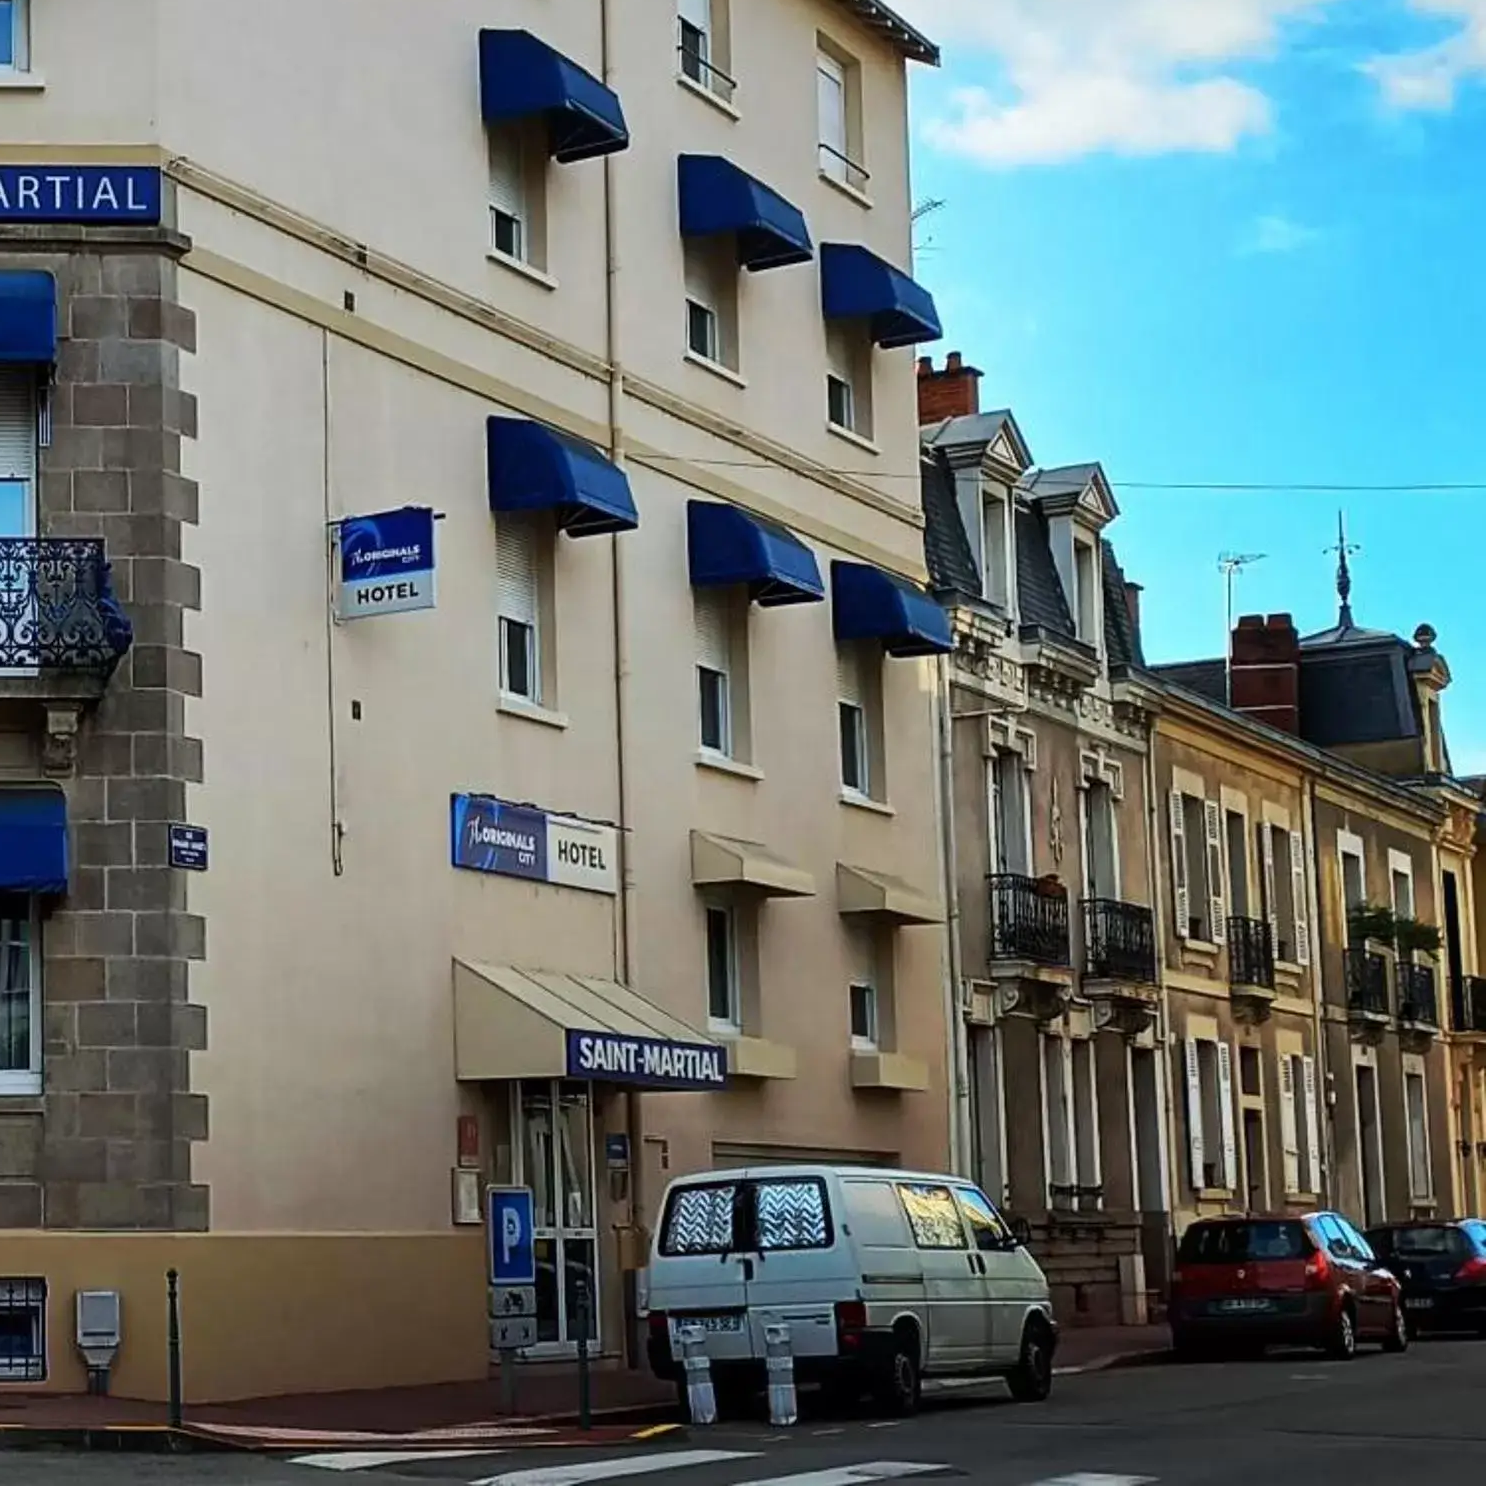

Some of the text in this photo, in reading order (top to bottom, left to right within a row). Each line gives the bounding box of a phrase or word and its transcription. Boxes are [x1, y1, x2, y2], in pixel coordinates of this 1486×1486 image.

[364, 545, 420, 561] ORIGINALS
[357, 582, 419, 605] HOTEL
[482, 826, 535, 851] ORIGINALS
[557, 839, 607, 870] HOTEL
[518, 851, 535, 866] CITY
[579, 1036, 724, 1083] SAINT-MARTIAL
[502, 1206, 522, 1264] P
